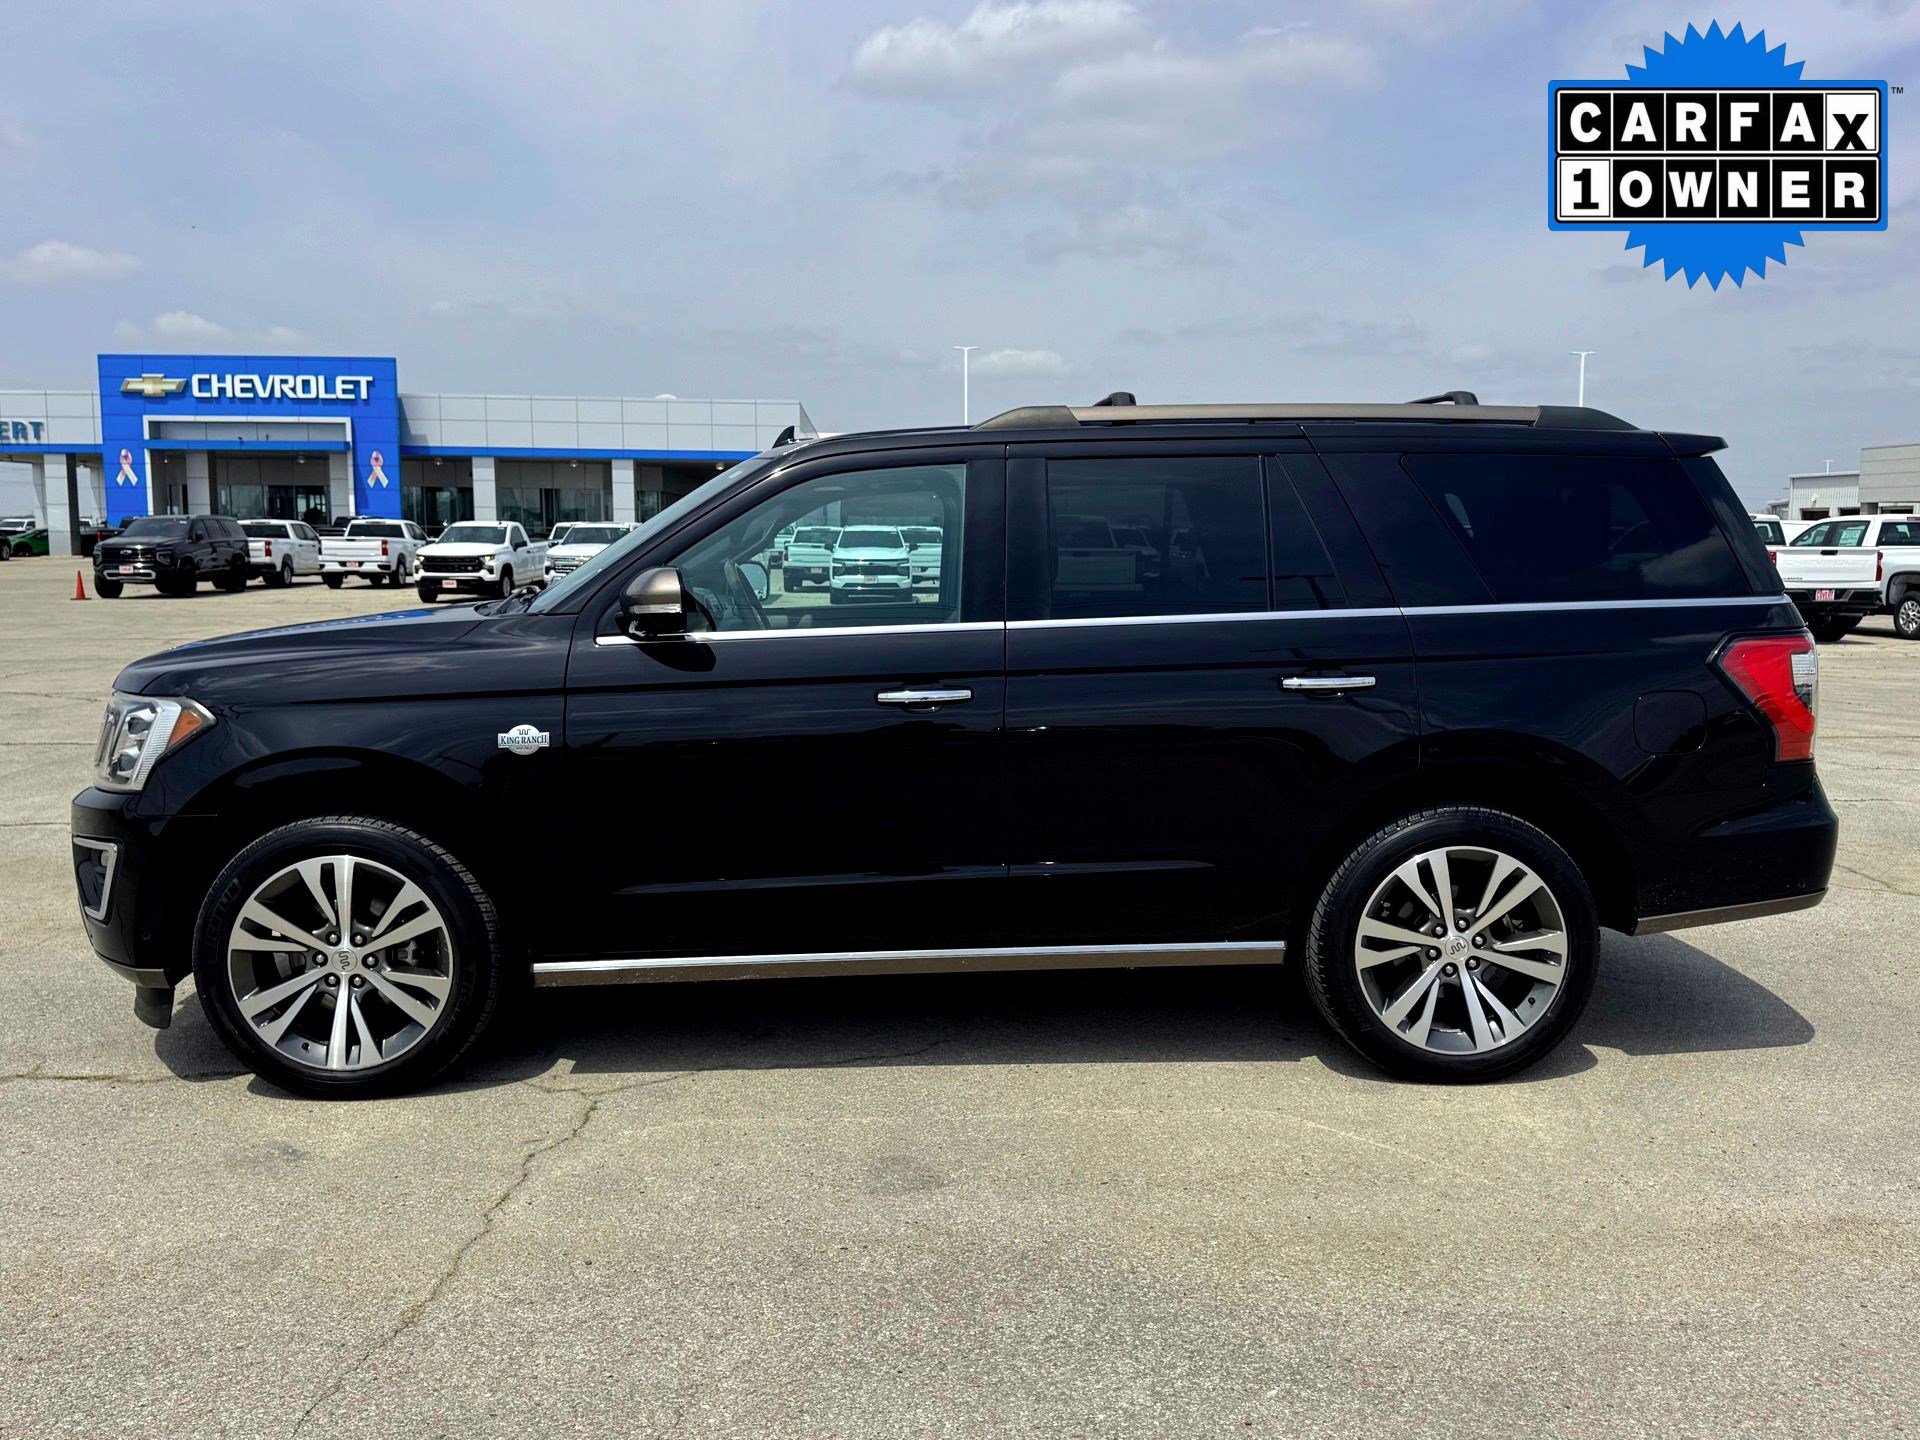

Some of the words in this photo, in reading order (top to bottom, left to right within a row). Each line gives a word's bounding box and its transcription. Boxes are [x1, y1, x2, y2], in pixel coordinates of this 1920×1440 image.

[191, 373, 374, 400] CHEVROLET
[500, 735, 520, 745] KING
[521, 734, 547, 744] RANCH
